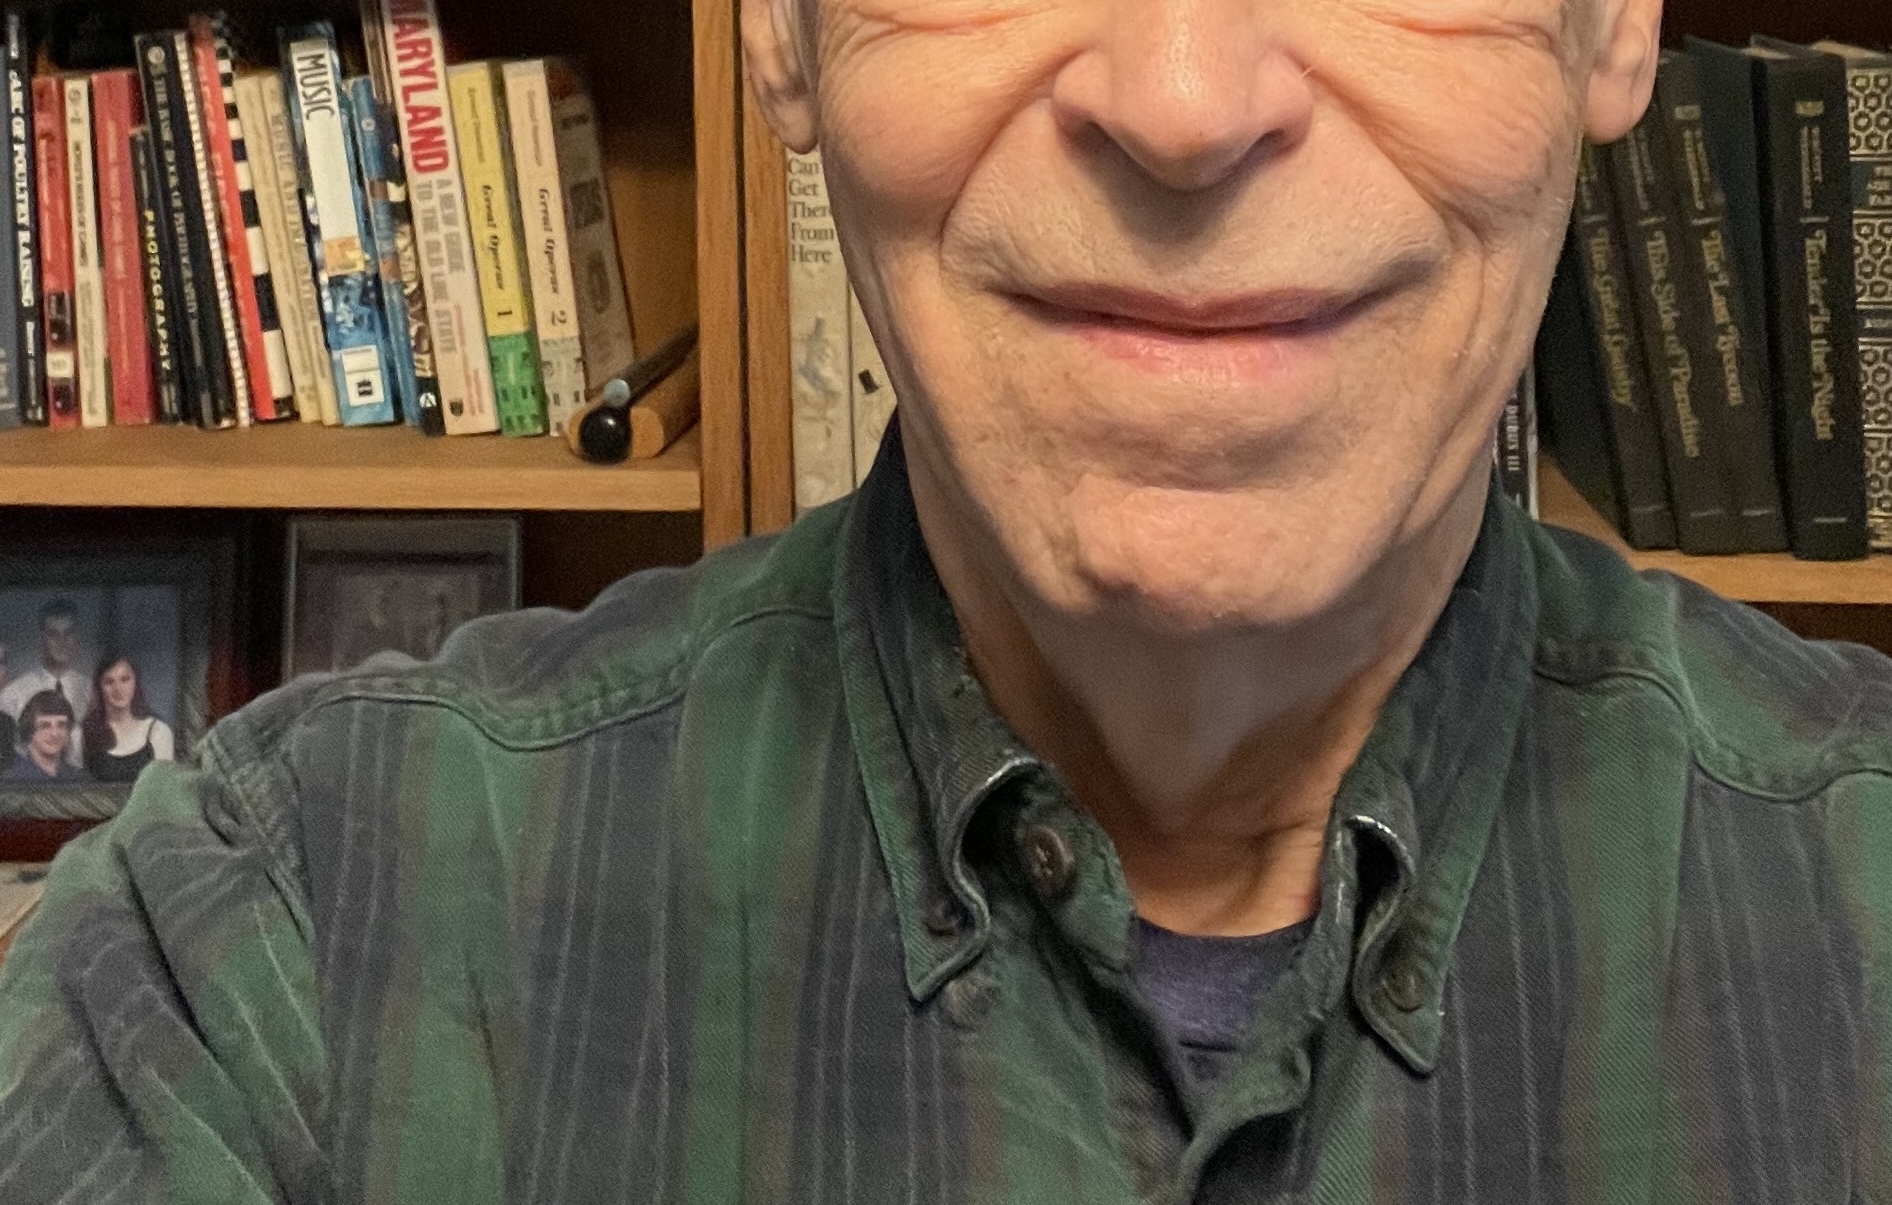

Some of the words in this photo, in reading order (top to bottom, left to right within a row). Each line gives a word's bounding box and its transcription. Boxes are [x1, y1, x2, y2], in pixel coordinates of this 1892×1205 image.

[295, 52, 336, 121] MUSIC
[11, 116, 26, 141] OF
[787, 156, 821, 175] Can
[13, 142, 31, 227] POULTRY
[415, 179, 434, 201] TO
[436, 178, 454, 190] A
[788, 178, 821, 197] Get
[422, 206, 440, 235] THE
[440, 192, 460, 227] NEW
[788, 200, 832, 219] Ther
[791, 221, 836, 242] From
[424, 239, 446, 268] OLD
[481, 183, 498, 229] Great
[496, 308, 513, 317] 1
[538, 187, 554, 233] Great
[551, 309, 567, 327] 2
[791, 243, 833, 264] Here
[17, 230, 35, 308] RAISING
[1804, 229, 1828, 306] Tender
[143, 208, 172, 371] PHOTOGRAPHY
[430, 271, 450, 302] LINE
[435, 308, 459, 355] STATE
